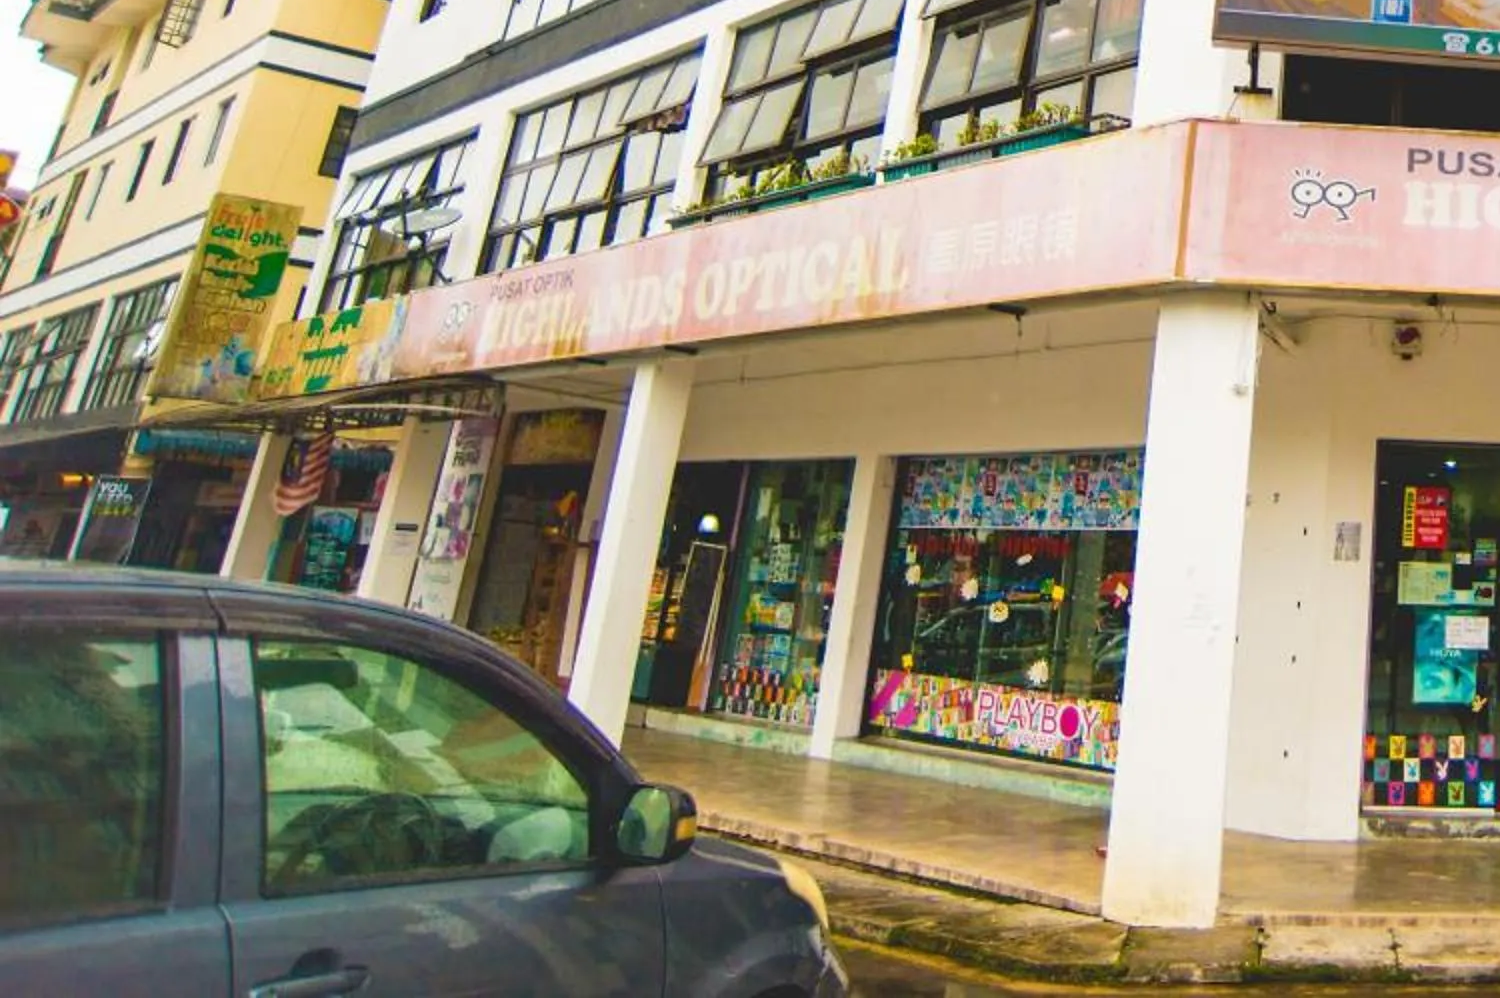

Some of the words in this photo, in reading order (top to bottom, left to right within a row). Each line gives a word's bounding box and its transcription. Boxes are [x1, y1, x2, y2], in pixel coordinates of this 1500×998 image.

[476, 271, 685, 354] HIGHLANDS
[694, 225, 909, 320] OPTICAL
[489, 277, 533, 300] PUSAT
[533, 268, 576, 295] OPTIK
[977, 688, 1099, 742] PLAYBOY
